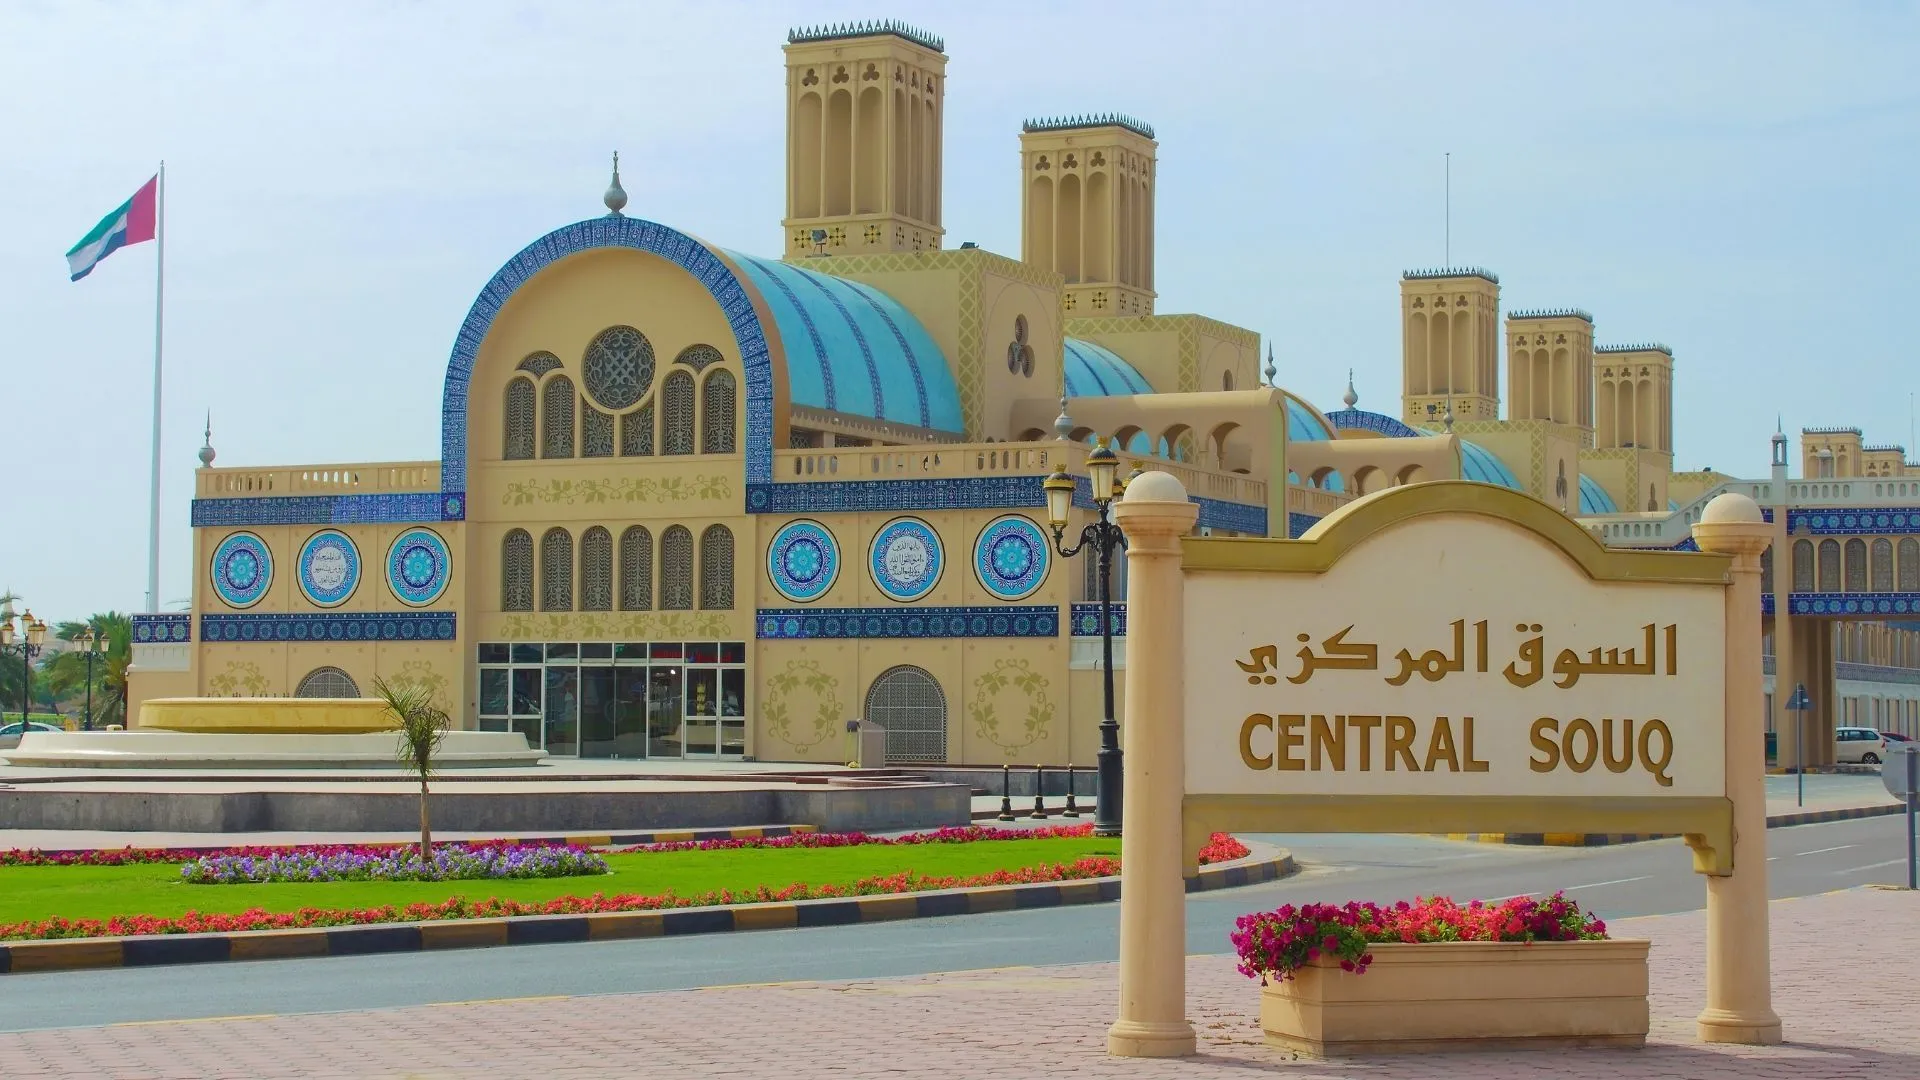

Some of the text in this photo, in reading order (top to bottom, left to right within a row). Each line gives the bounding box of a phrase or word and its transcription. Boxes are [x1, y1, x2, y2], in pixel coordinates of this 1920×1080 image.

[1236, 619, 1677, 689] السوق المركزي
[1239, 713, 1673, 786] CENTRAL SOUQ
